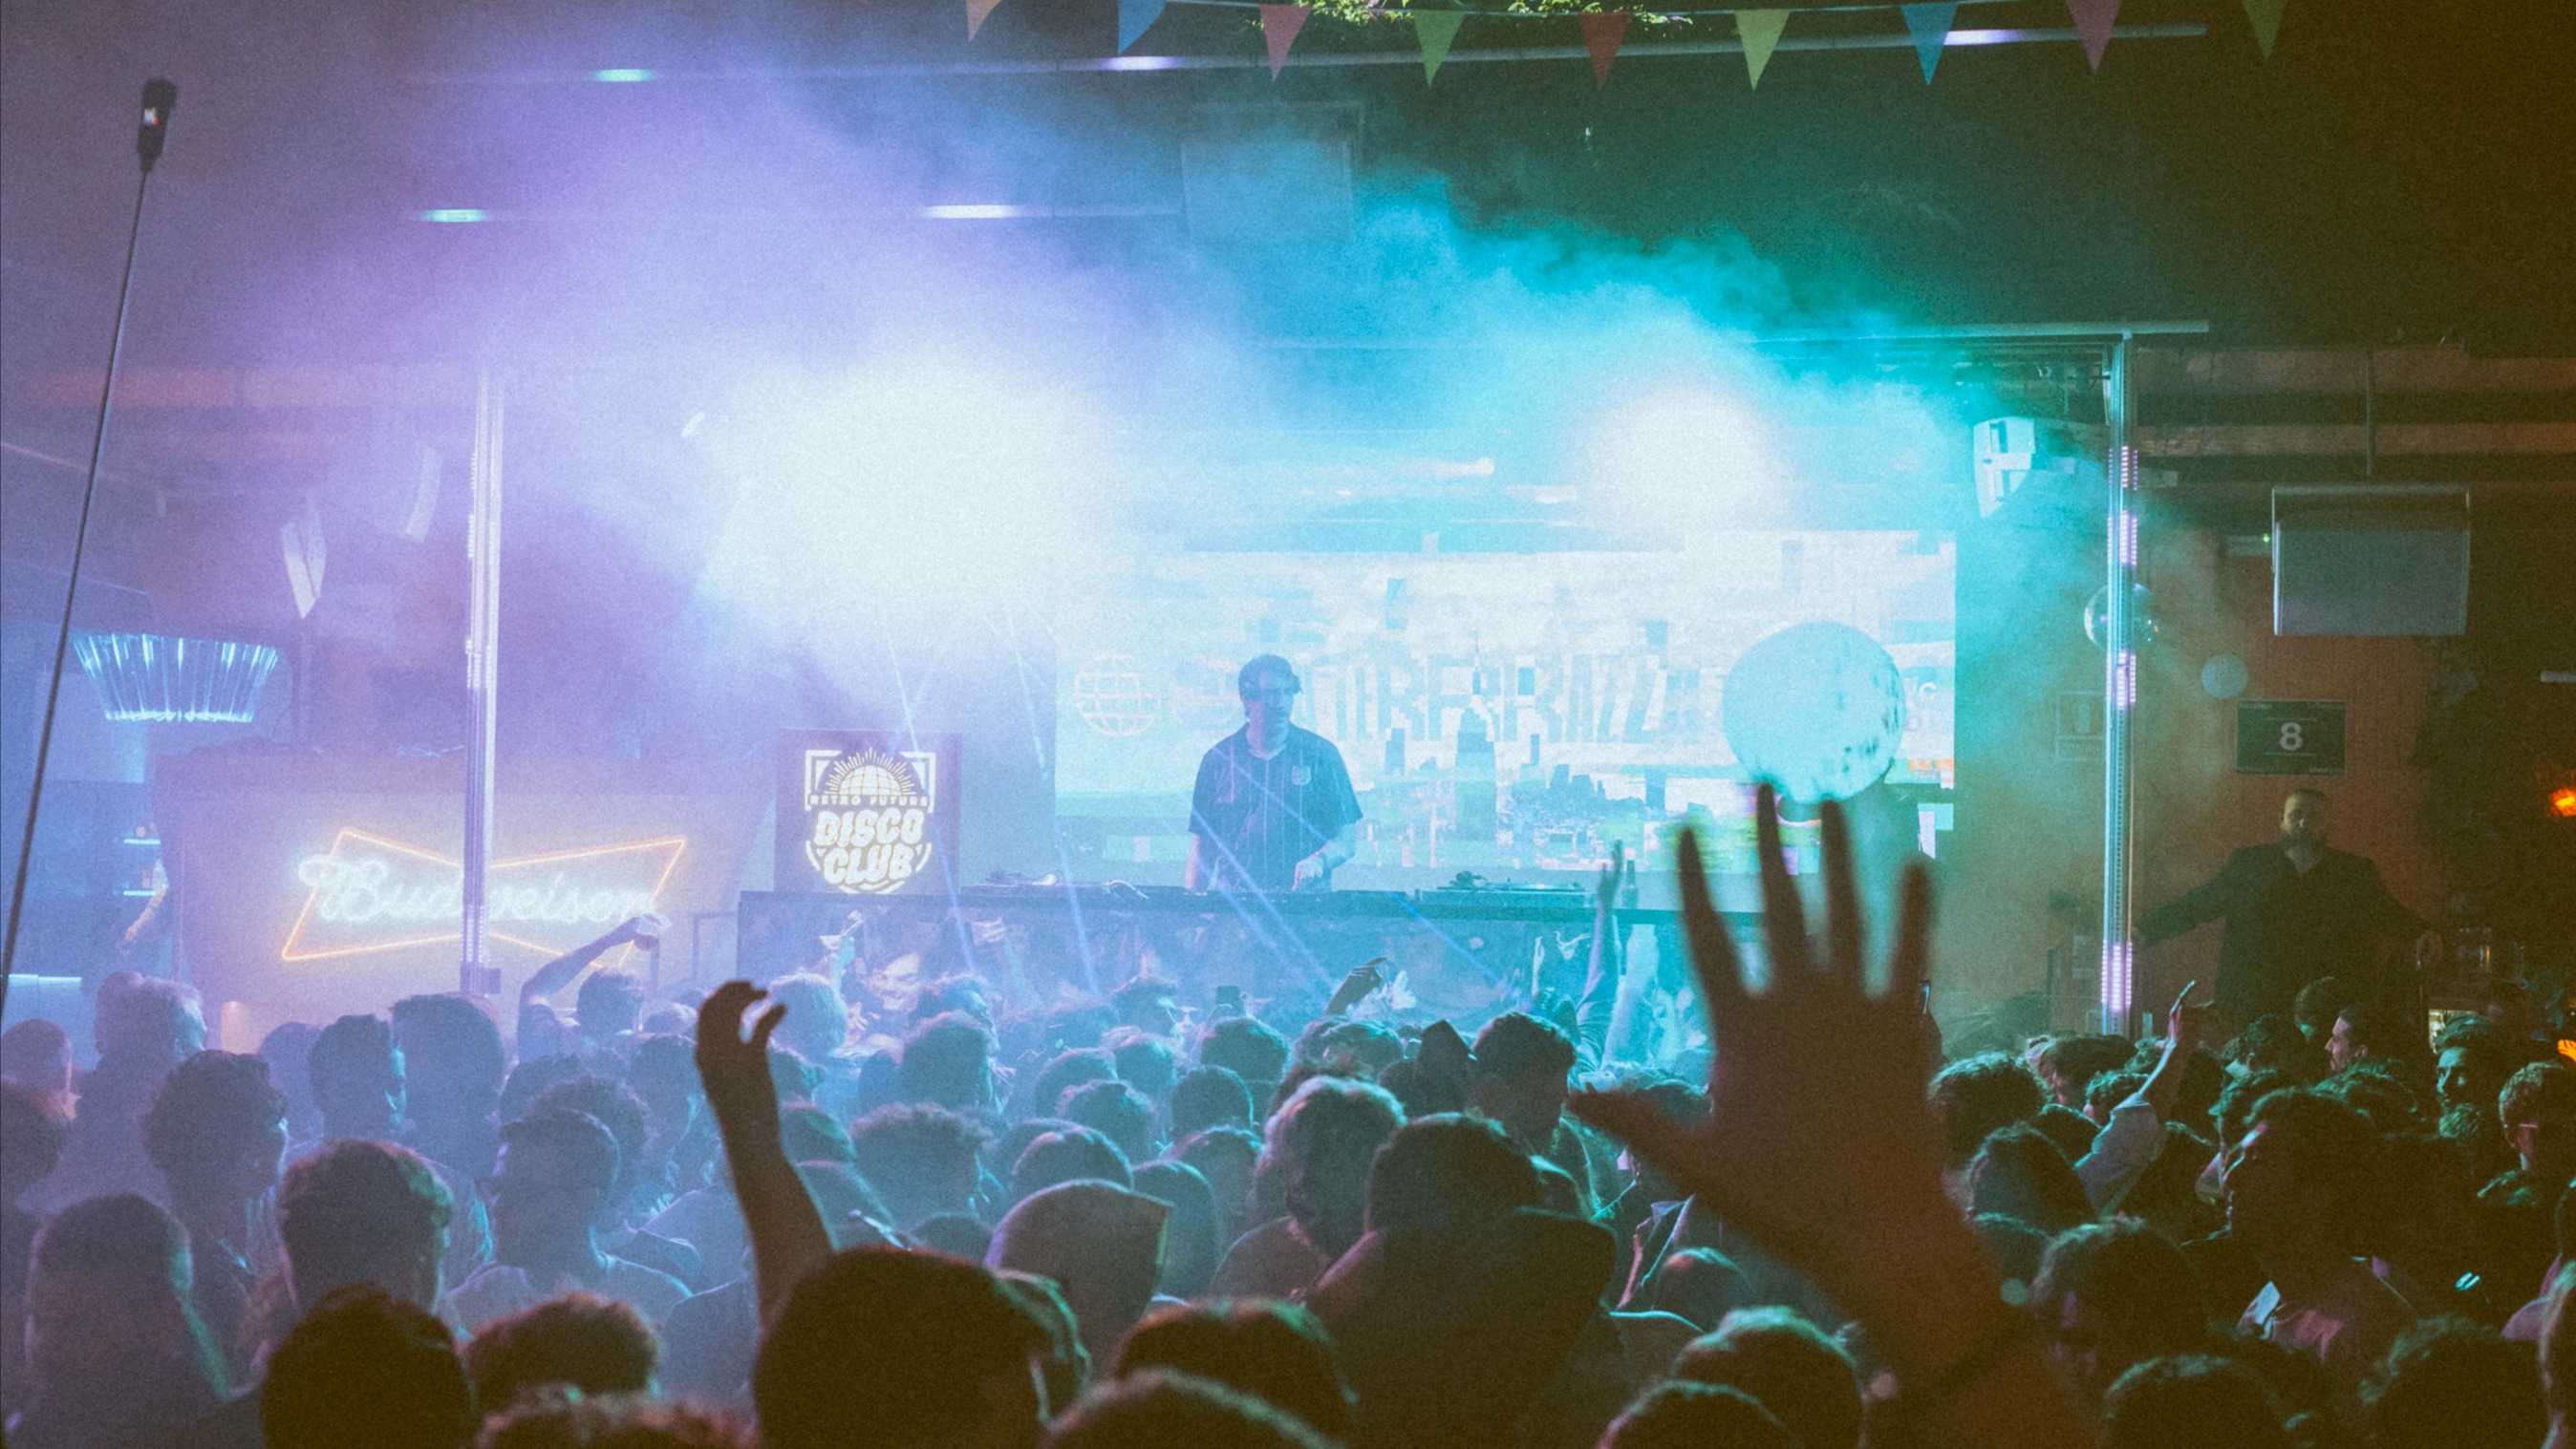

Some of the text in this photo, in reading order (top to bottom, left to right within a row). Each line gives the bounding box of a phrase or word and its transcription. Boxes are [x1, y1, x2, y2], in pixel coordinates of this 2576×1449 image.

[2280, 722, 2303, 751] 8
[810, 795, 928, 807] RETRO FUTURE
[814, 807, 924, 847] DISCO
[823, 842, 914, 884] CLUB
